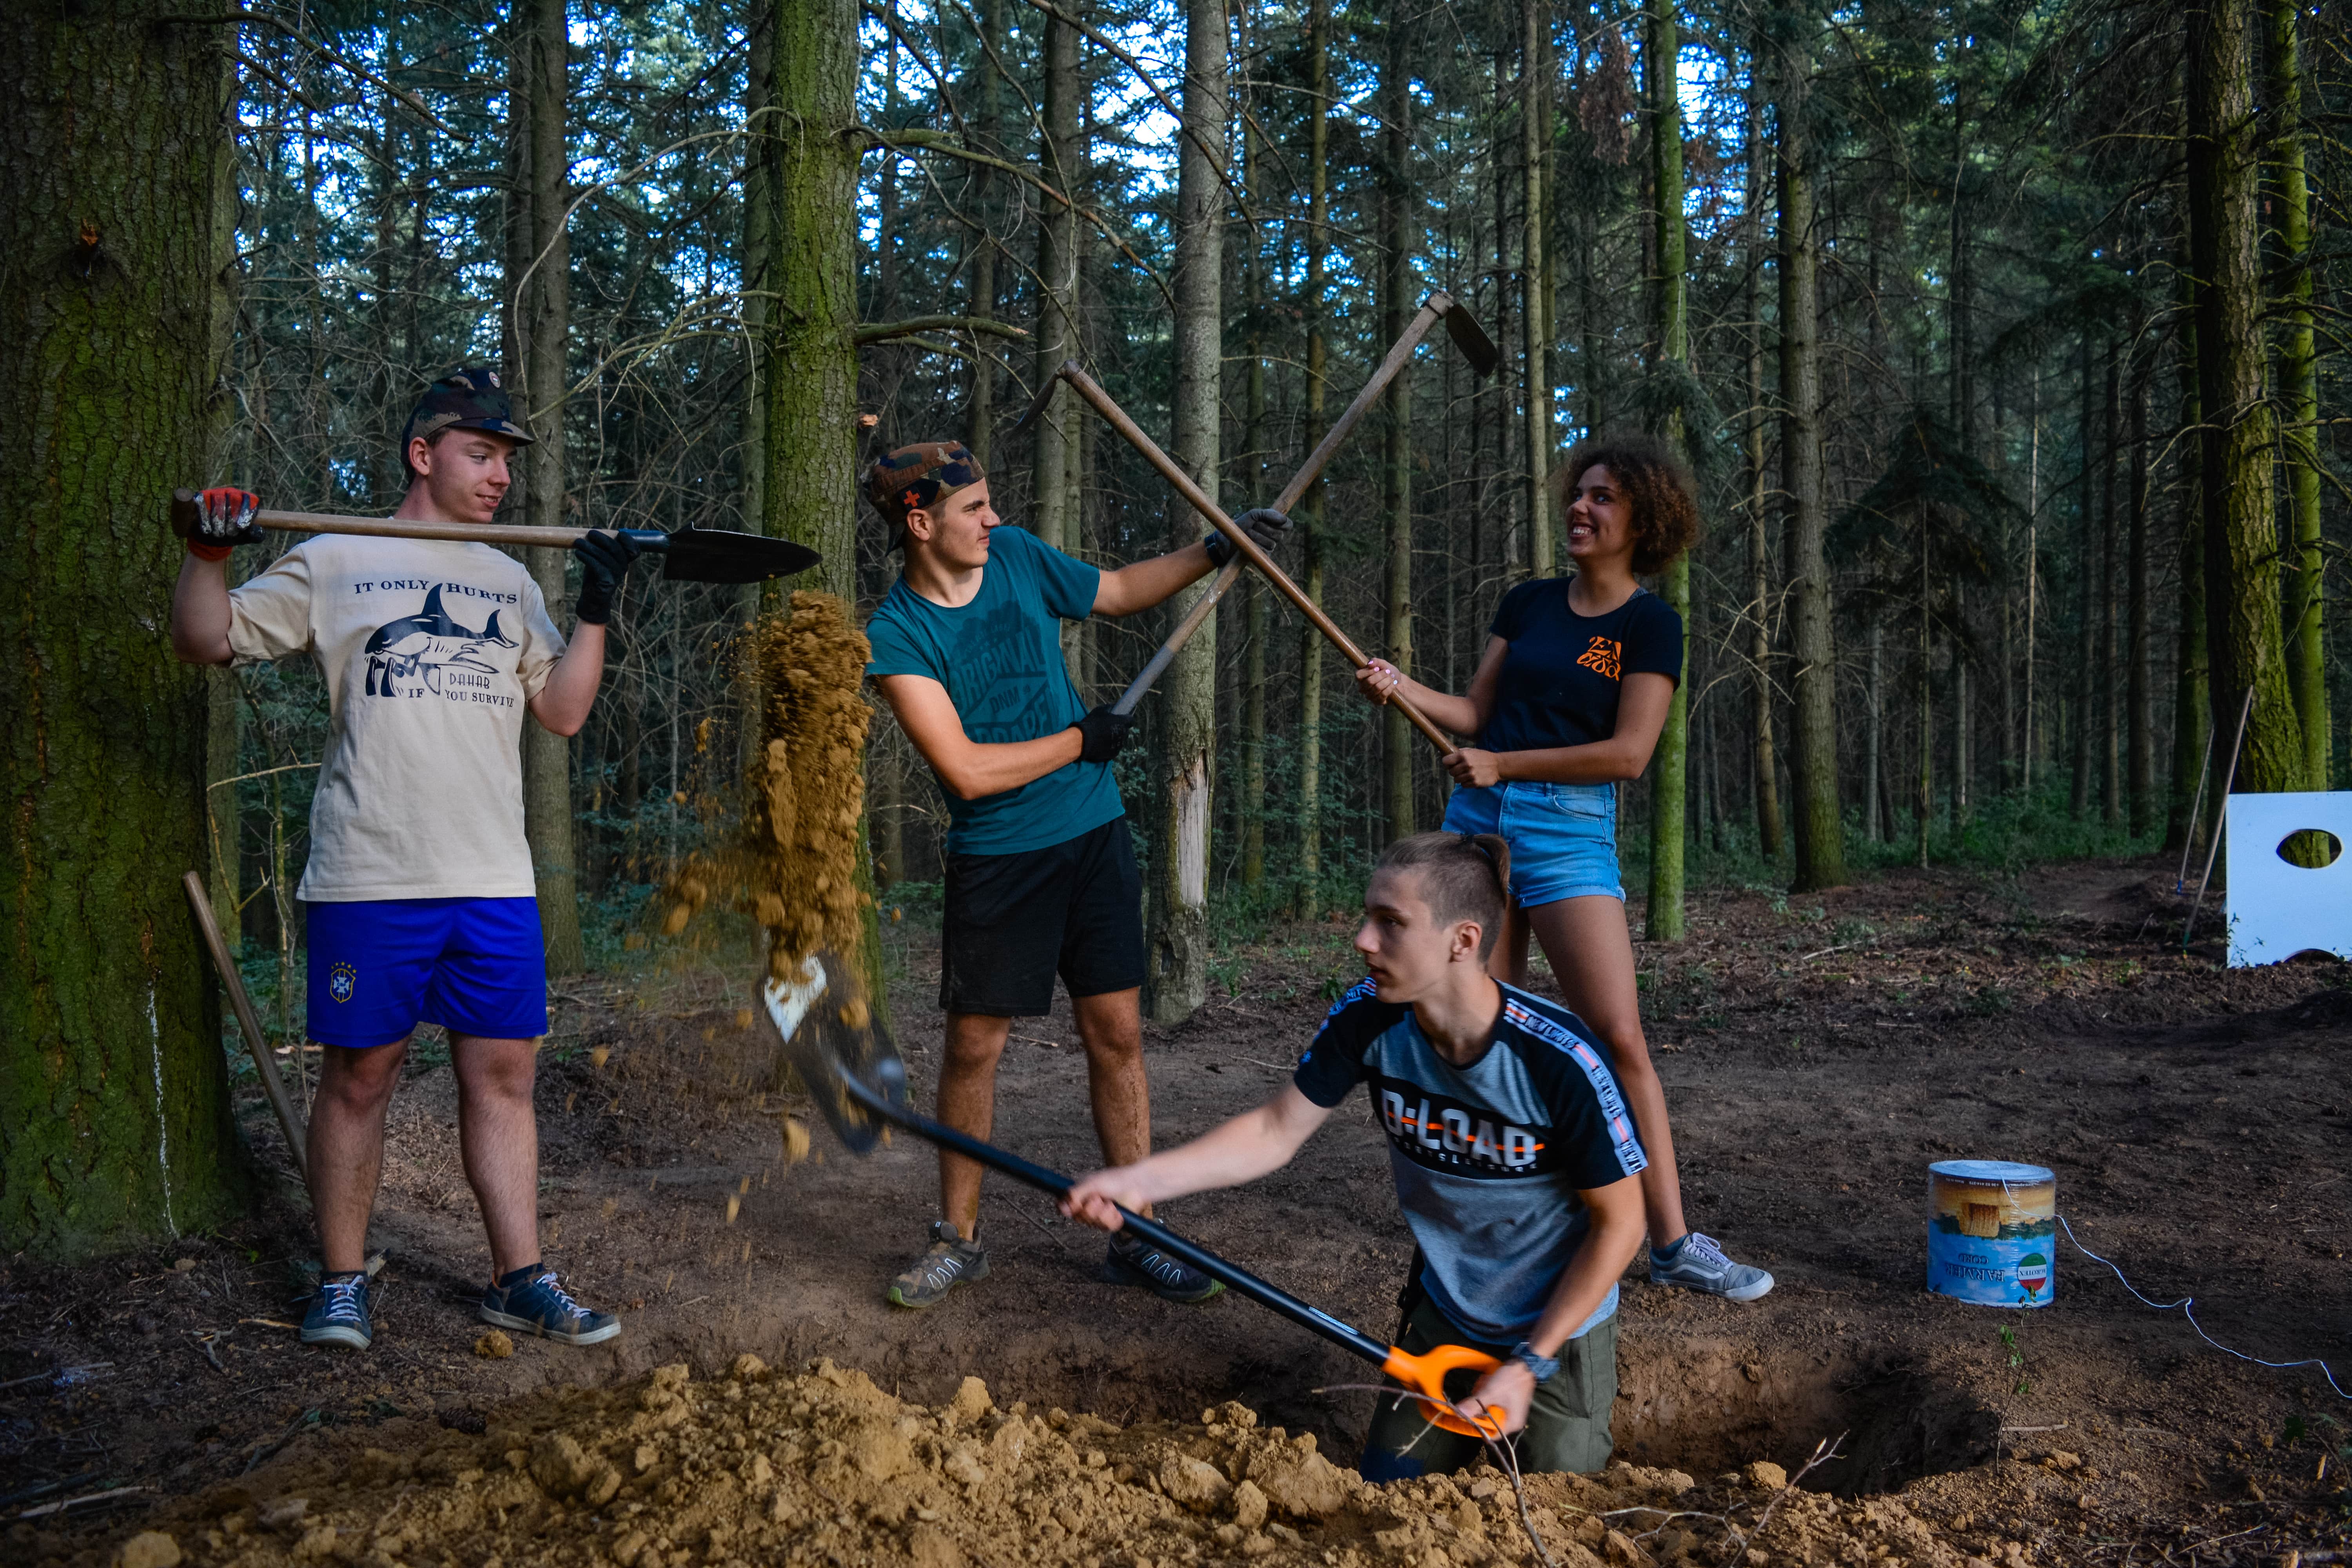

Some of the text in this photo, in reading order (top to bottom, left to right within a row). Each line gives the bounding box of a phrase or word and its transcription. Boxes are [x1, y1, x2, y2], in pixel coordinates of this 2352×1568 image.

[354, 579, 517, 604] IT ONLY HURTS
[449, 672, 490, 689] DAHAB
[950, 626, 1047, 717] ORIGINAL
[408, 688, 514, 708] IF YOU SURVIVE
[989, 686, 1021, 714] DNM
[1958, 1254, 1989, 1264] CORD
[1946, 1263, 2005, 1282] FARMER
[2020, 1269, 2047, 1277] AGROTEX
